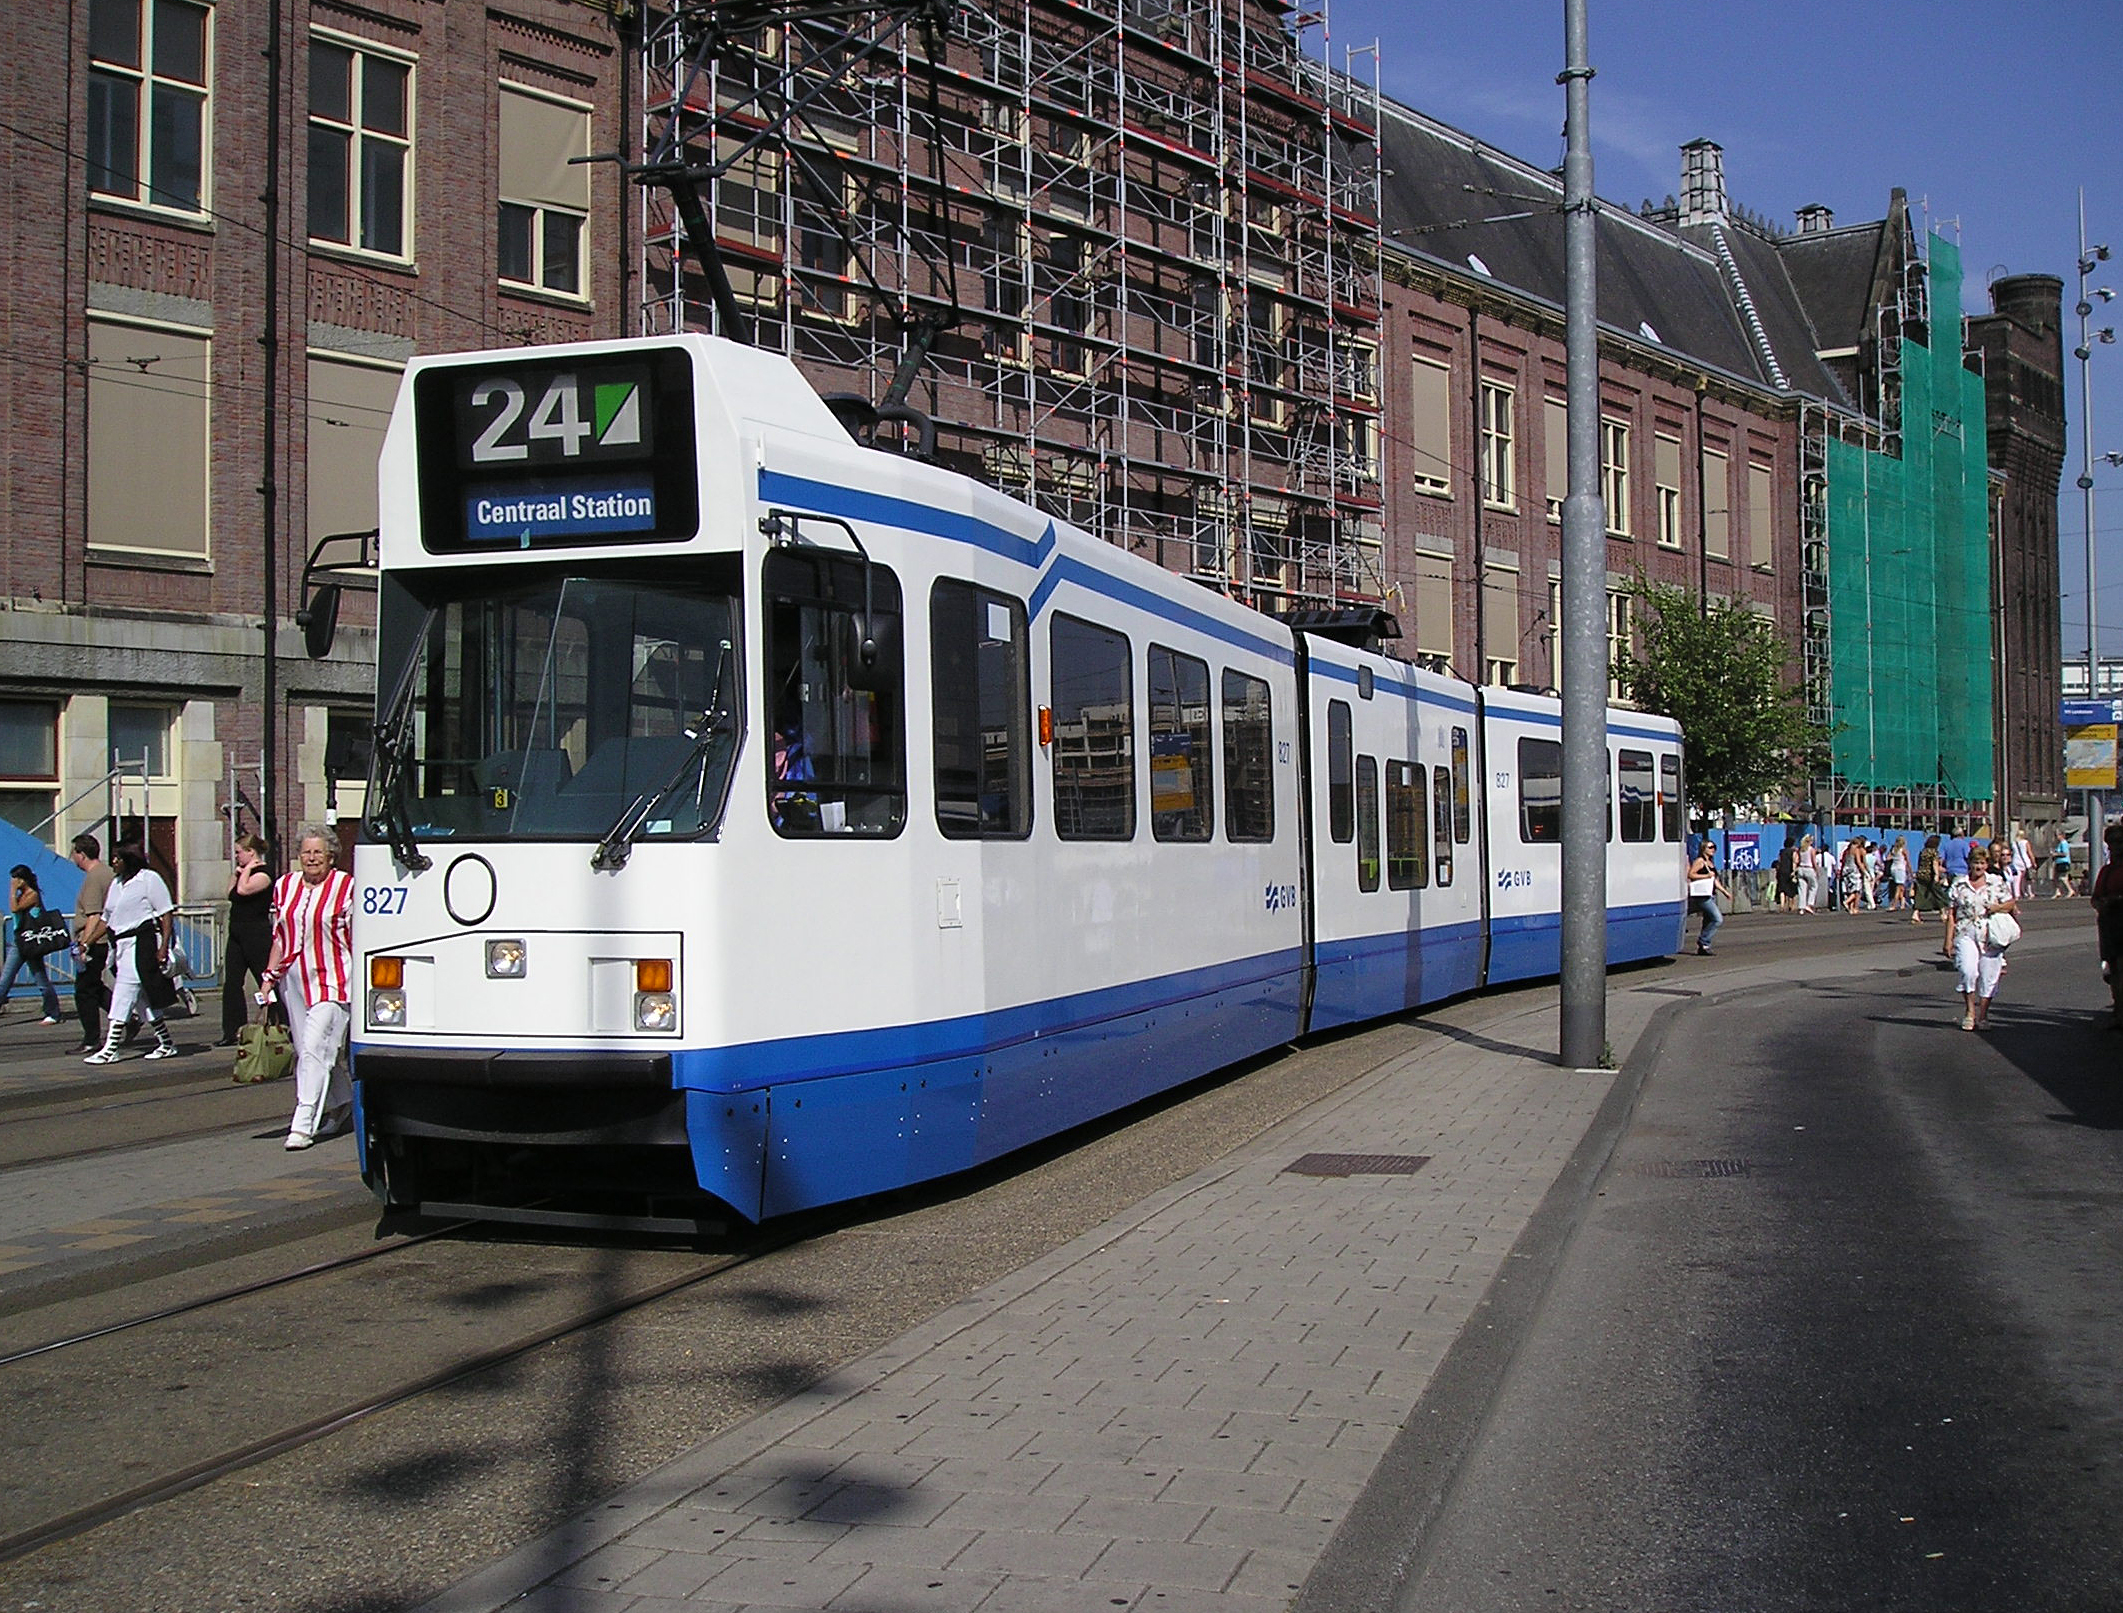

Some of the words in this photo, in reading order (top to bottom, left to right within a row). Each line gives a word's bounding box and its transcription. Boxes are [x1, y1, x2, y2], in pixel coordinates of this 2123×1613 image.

[472, 374, 591, 462] 24
[477, 496, 566, 524] Centraal
[572, 493, 651, 519] Station
[1278, 740, 1290, 765] 827
[1496, 772, 1510, 788] 827
[1514, 870, 1532, 887] GVB
[363, 887, 408, 914] 827
[1280, 885, 1296, 908] GVB
